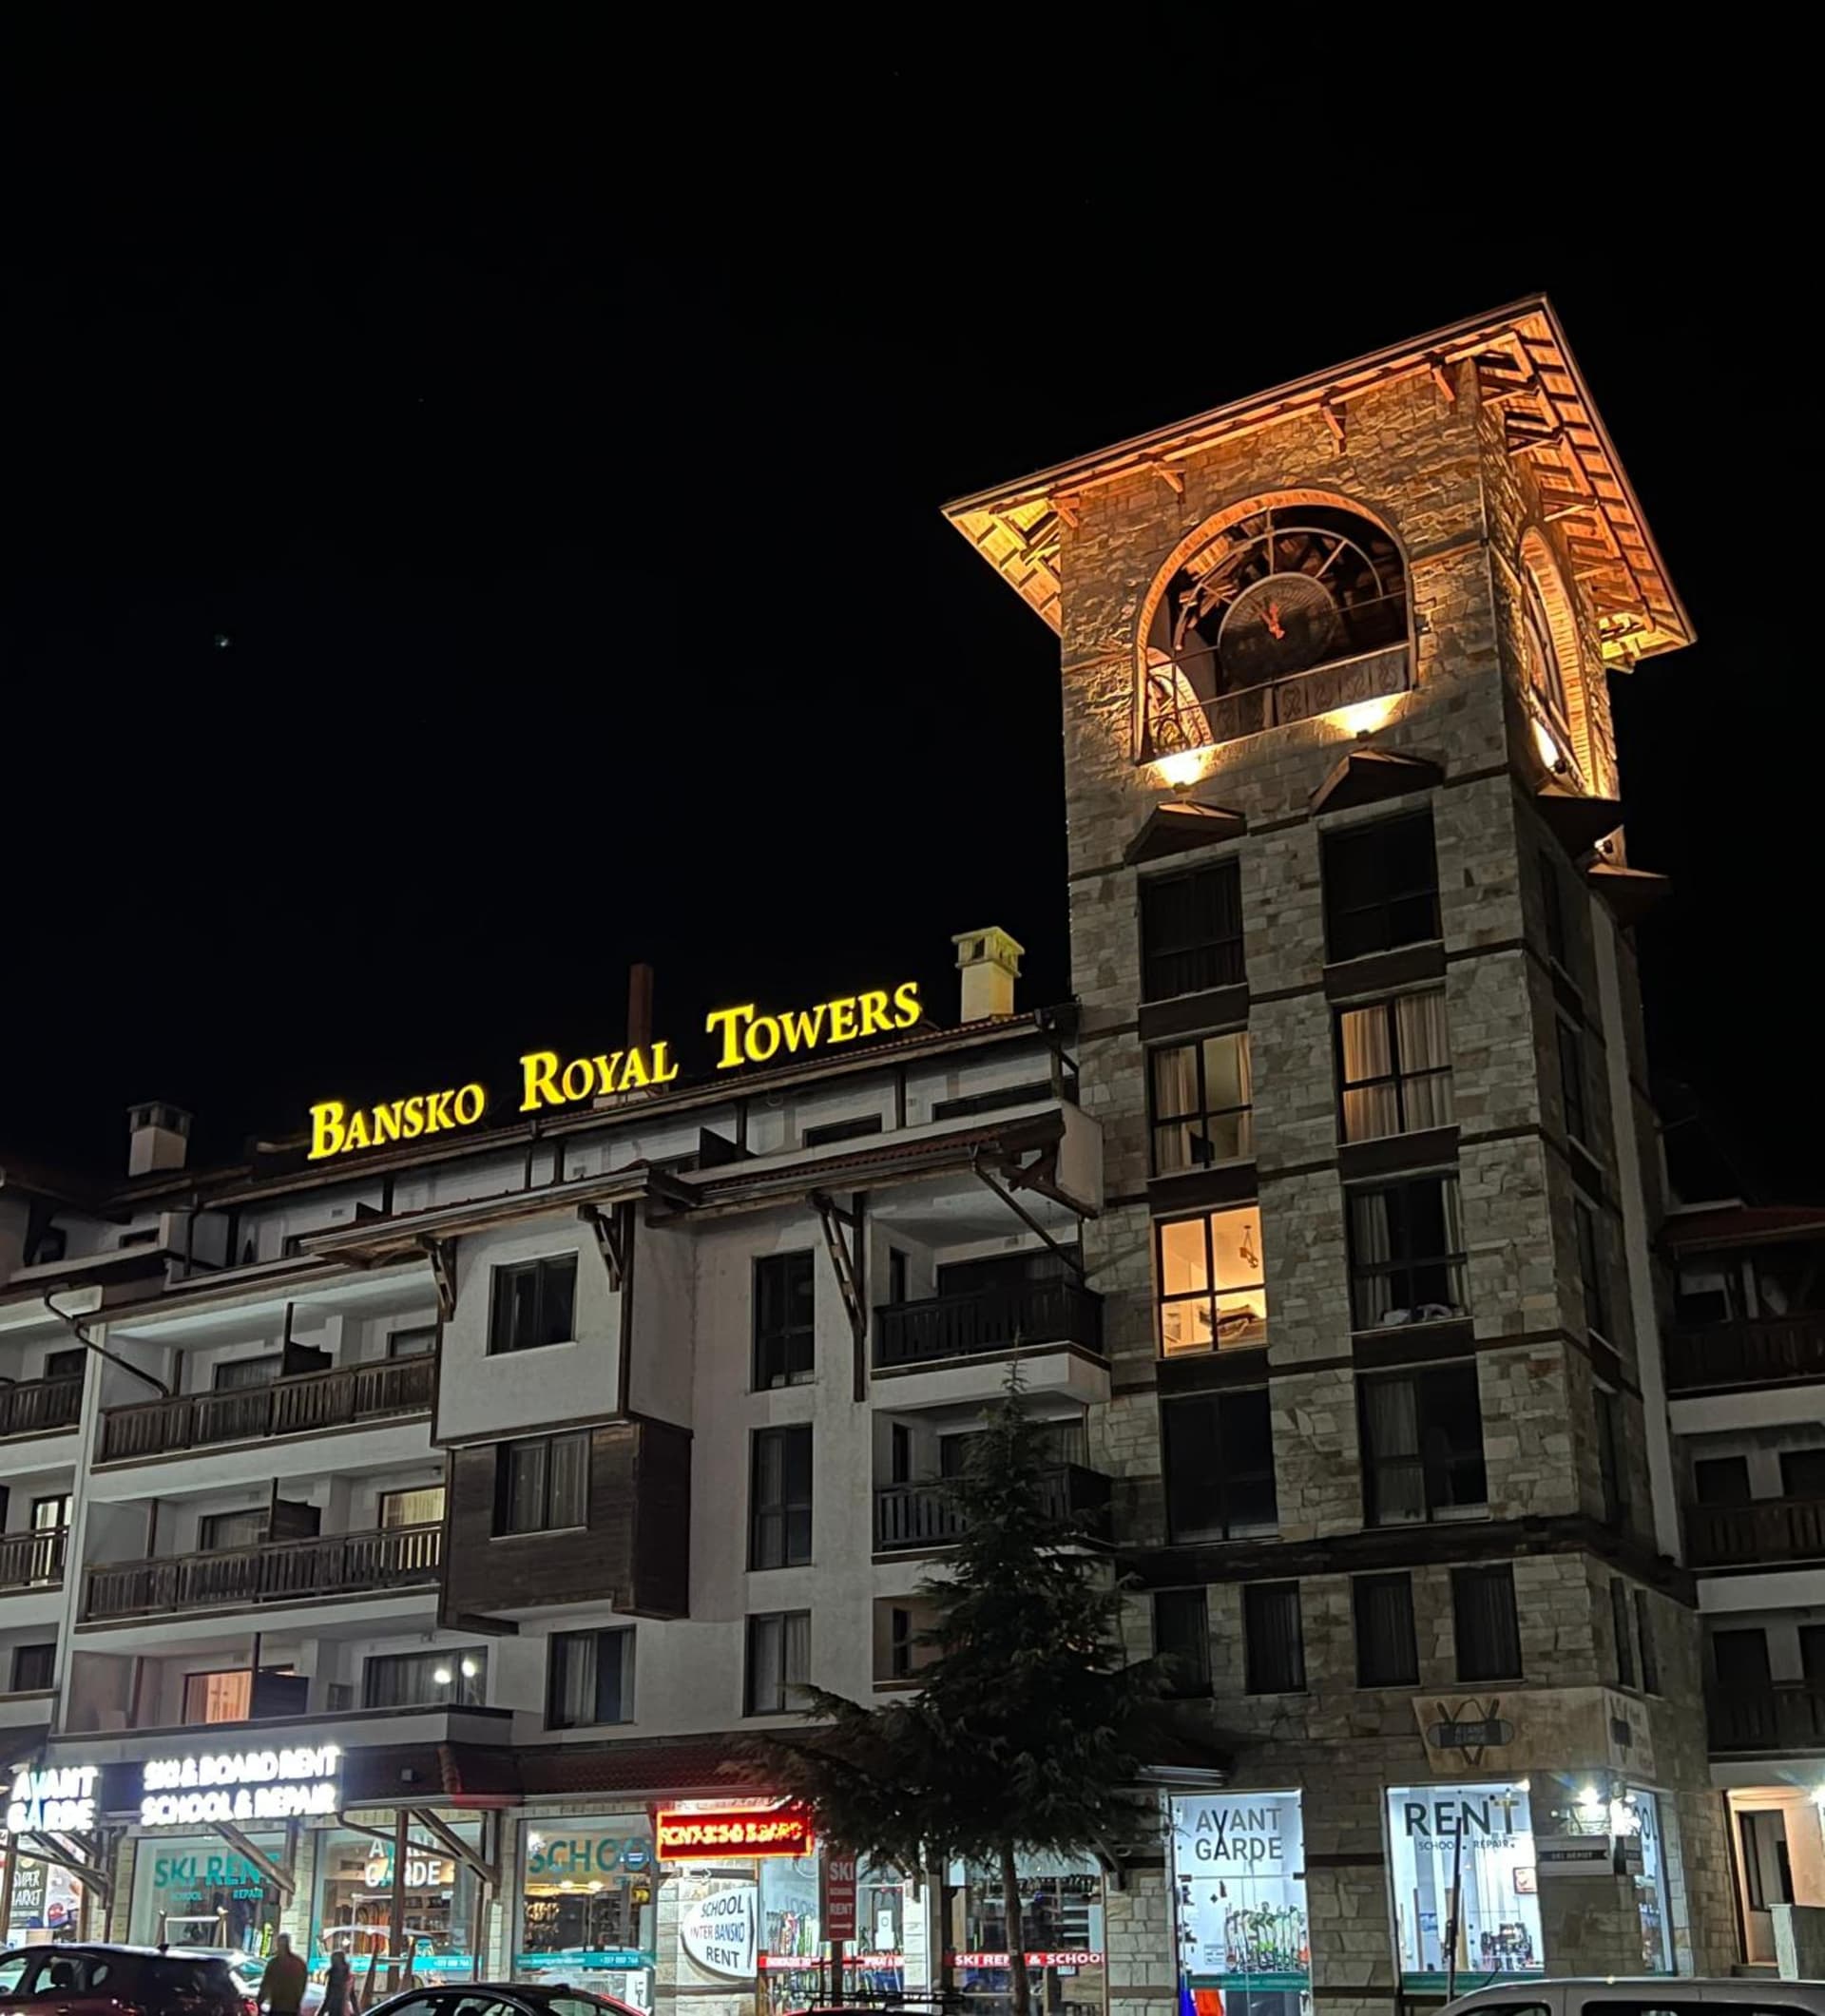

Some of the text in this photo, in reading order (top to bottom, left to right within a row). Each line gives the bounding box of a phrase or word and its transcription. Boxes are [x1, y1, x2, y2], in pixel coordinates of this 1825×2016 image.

[307, 981, 921, 1160] BANSKO ROYAL TOWERS
[144, 1743, 341, 1791] SKI & BOARD RENT
[11, 1766, 99, 1801] AVANT
[7, 1797, 95, 1834] GARDE
[141, 1782, 336, 1827] SCHOOL & REPAIR
[1195, 1808, 1282, 1834] AVANT
[1404, 1800, 1519, 1836] RENT
[1195, 1836, 1283, 1861] GARDE
[154, 1856, 197, 1888] SKI
[829, 1862, 855, 1881] SKI
[701, 1895, 744, 1917] SCHOOL
[830, 1902, 853, 1915] RENT
[690, 1922, 745, 1943] INTER BANSKO
[706, 1946, 740, 1968] RENT
[954, 1954, 979, 1967] SKI
[1029, 1954, 1041, 1965] &
